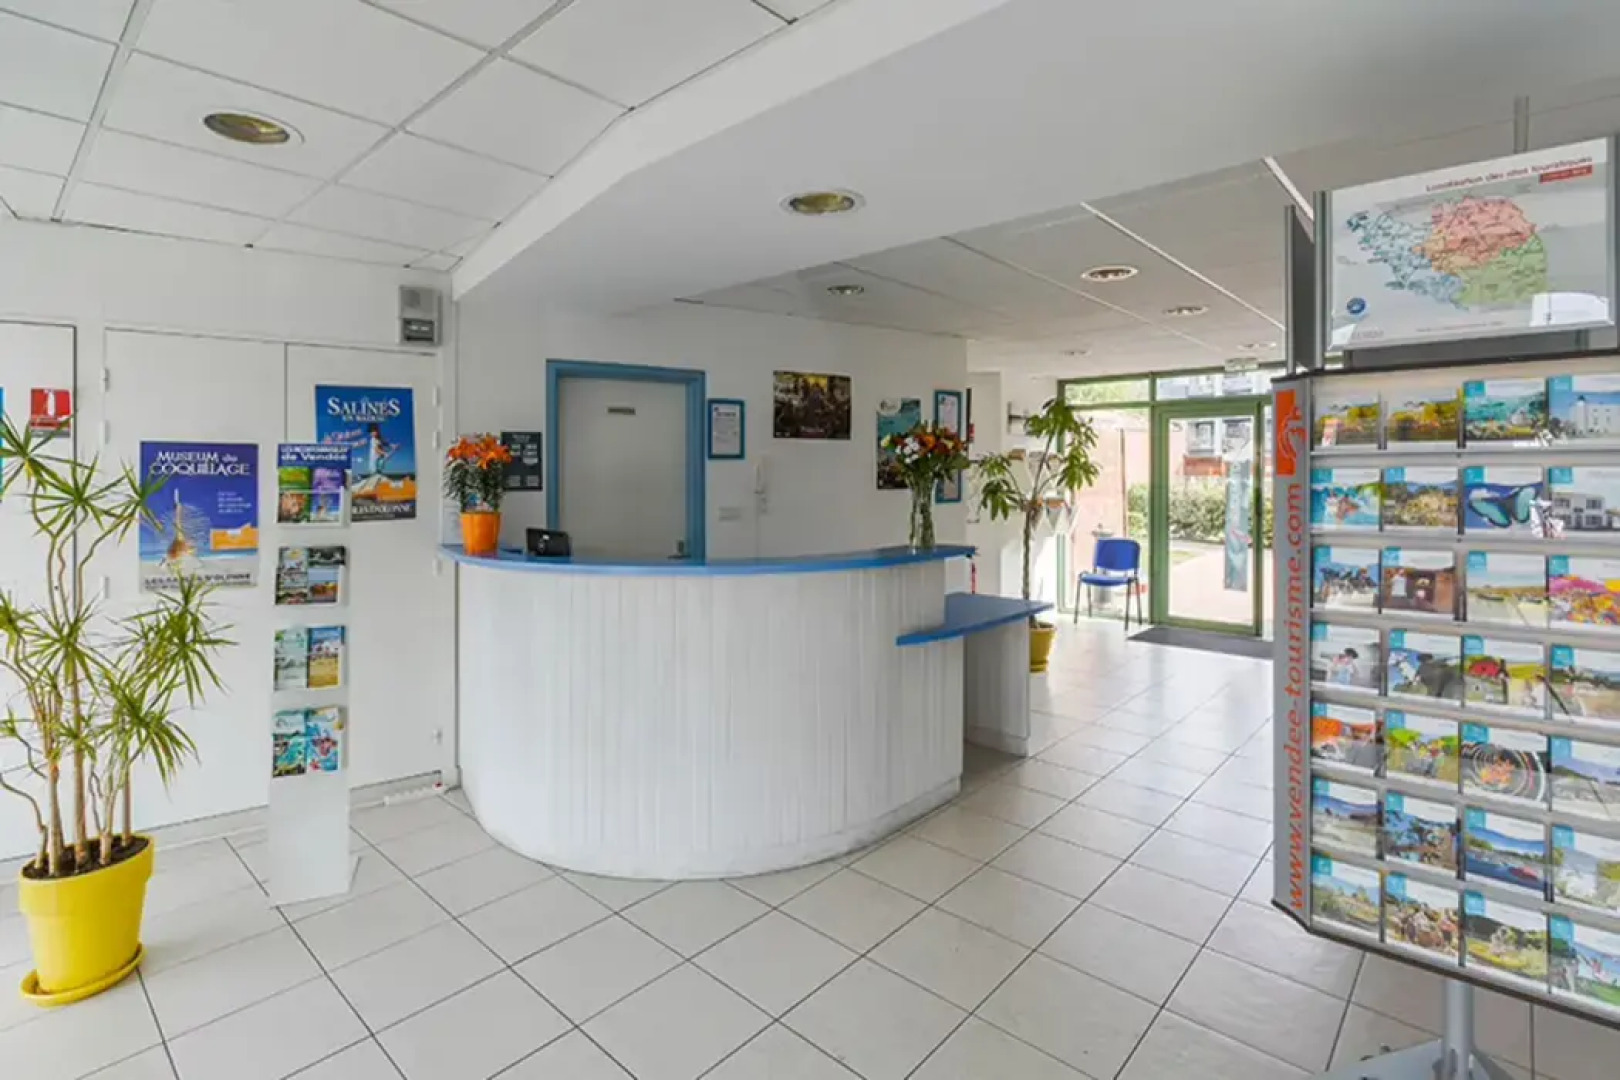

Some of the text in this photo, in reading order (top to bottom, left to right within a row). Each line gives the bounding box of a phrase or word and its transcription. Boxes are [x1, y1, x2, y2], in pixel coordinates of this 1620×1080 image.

[156, 451, 219, 462] MUSEUM
[149, 461, 251, 477] COQUILLAGE
[1284, 482, 1304, 909] www.vendee-tourisme.com
